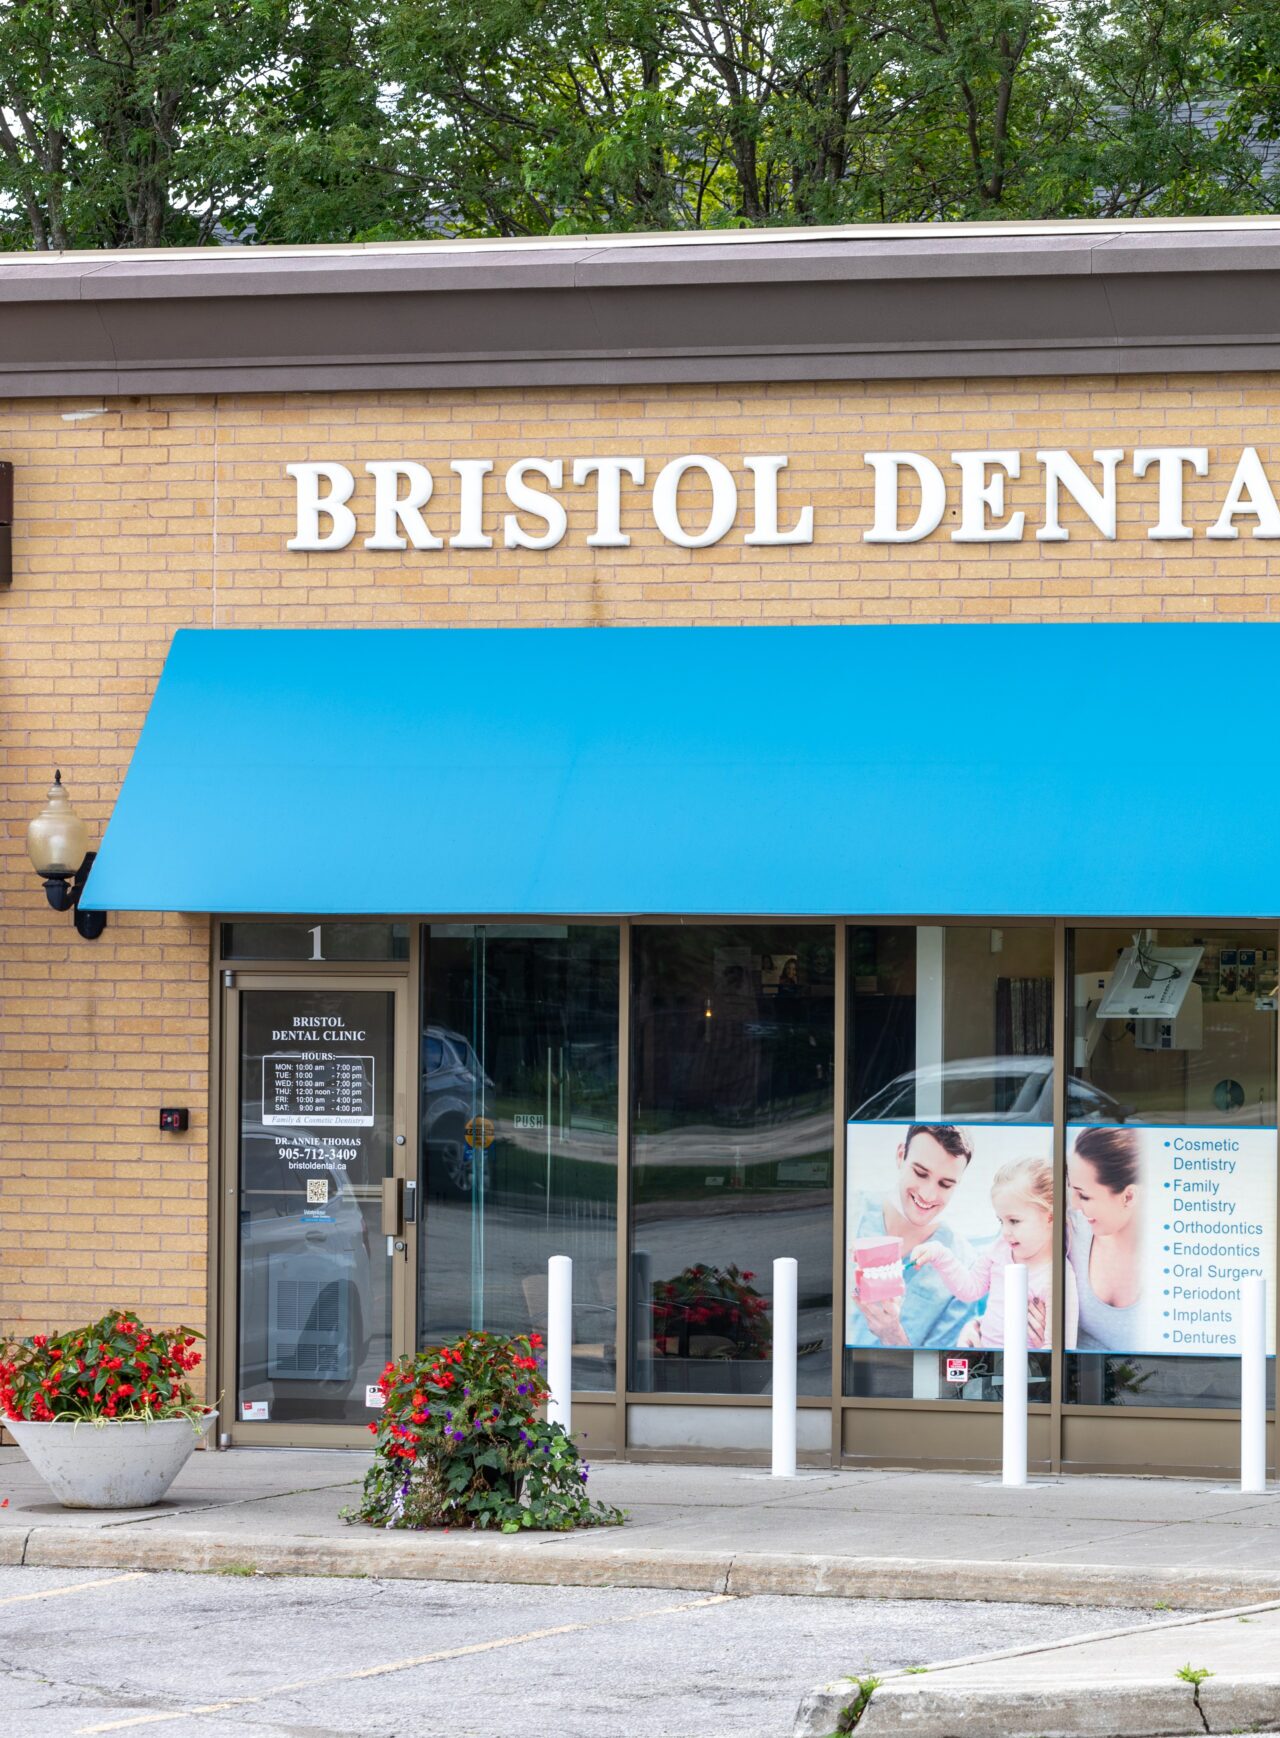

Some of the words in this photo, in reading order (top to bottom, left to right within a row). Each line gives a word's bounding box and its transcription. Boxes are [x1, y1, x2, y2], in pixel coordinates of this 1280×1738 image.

[286, 454, 814, 551] BRISTOL
[307, 925, 326, 960] 1
[293, 1017, 345, 1027] BRISTOL
[272, 1031, 320, 1041] DENTAL
[323, 1031, 366, 1041] CLINIC
[301, 1053, 336, 1061] HOURS:
[272, 1116, 294, 1124] Family
[304, 1116, 333, 1124] Cosmetic
[335, 1116, 365, 1125] Dentistry
[515, 1116, 543, 1127] PUSH
[275, 1137, 290, 1145] DR.
[292, 1138, 320, 1146] ANNIE
[322, 1138, 361, 1146] THOMAS
[1173, 1138, 1239, 1152] Cosmetic
[279, 1148, 357, 1160] 905-712-3409
[288, 1162, 347, 1170] bristoldental.ca
[1173, 1157, 1236, 1174] Dentistry
[1173, 1179, 1220, 1195] Family
[1173, 1199, 1236, 1216] Dentistry
[1173, 1220, 1263, 1235] Orthodontics
[1173, 1242, 1260, 1257] Endodontics
[1173, 1264, 1202, 1278] Oral
[1173, 1286, 1241, 1301] Periodont
[1173, 1308, 1232, 1324] Implants
[1173, 1331, 1236, 1344] Dentures
